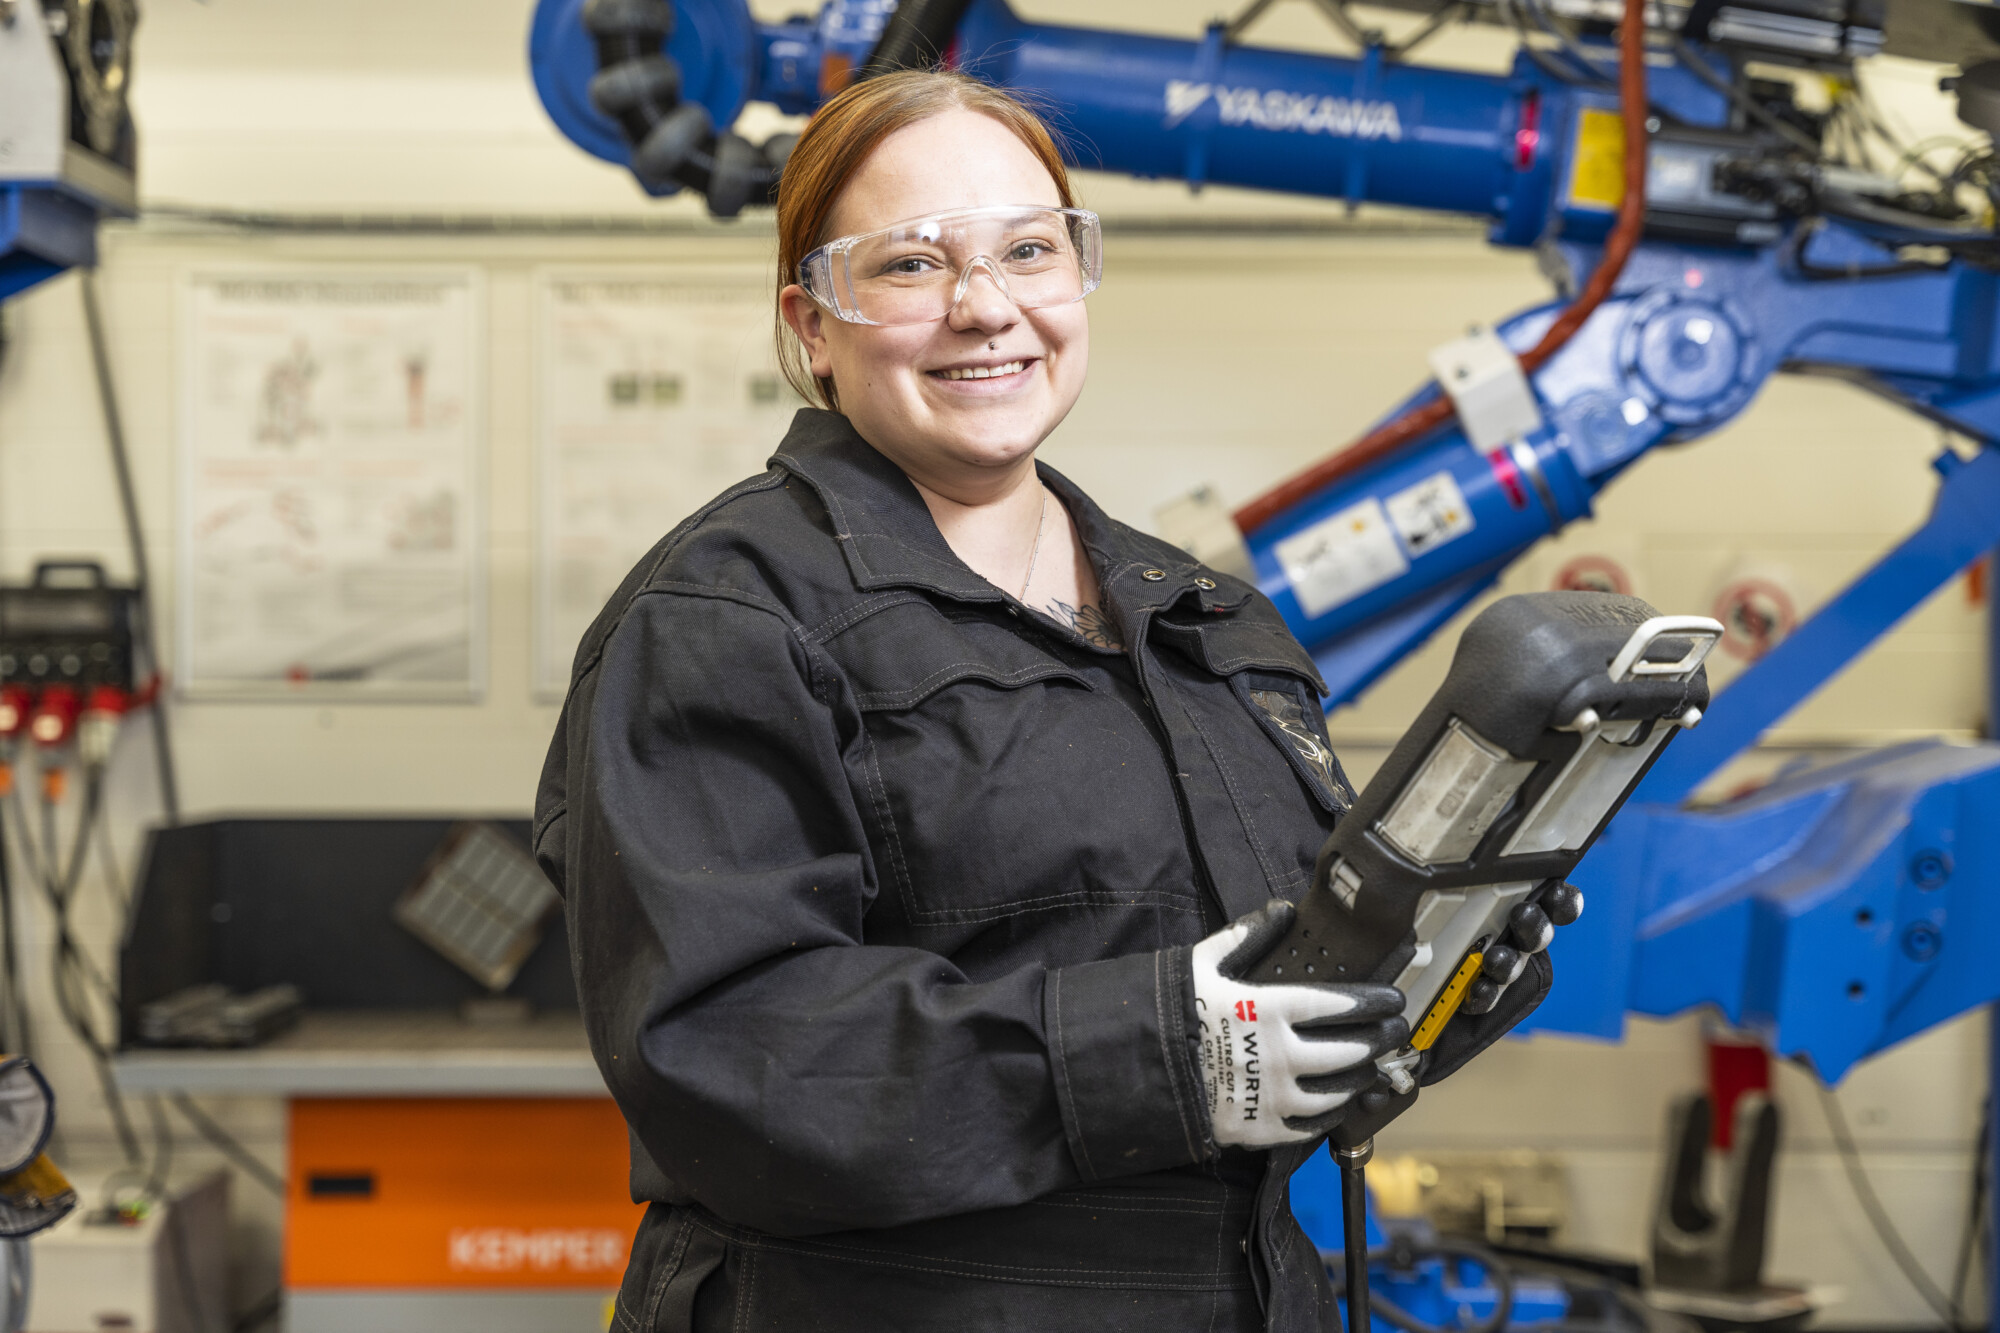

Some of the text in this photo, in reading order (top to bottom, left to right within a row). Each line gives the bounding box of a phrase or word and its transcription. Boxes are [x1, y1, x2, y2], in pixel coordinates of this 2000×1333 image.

[1215, 86, 1401, 142] YASKAWA
[1221, 1017, 1235, 1104] CULTRO CUT C
[1243, 1031, 1260, 1121] WÜRTH
[450, 1229, 624, 1270] KEMPER
